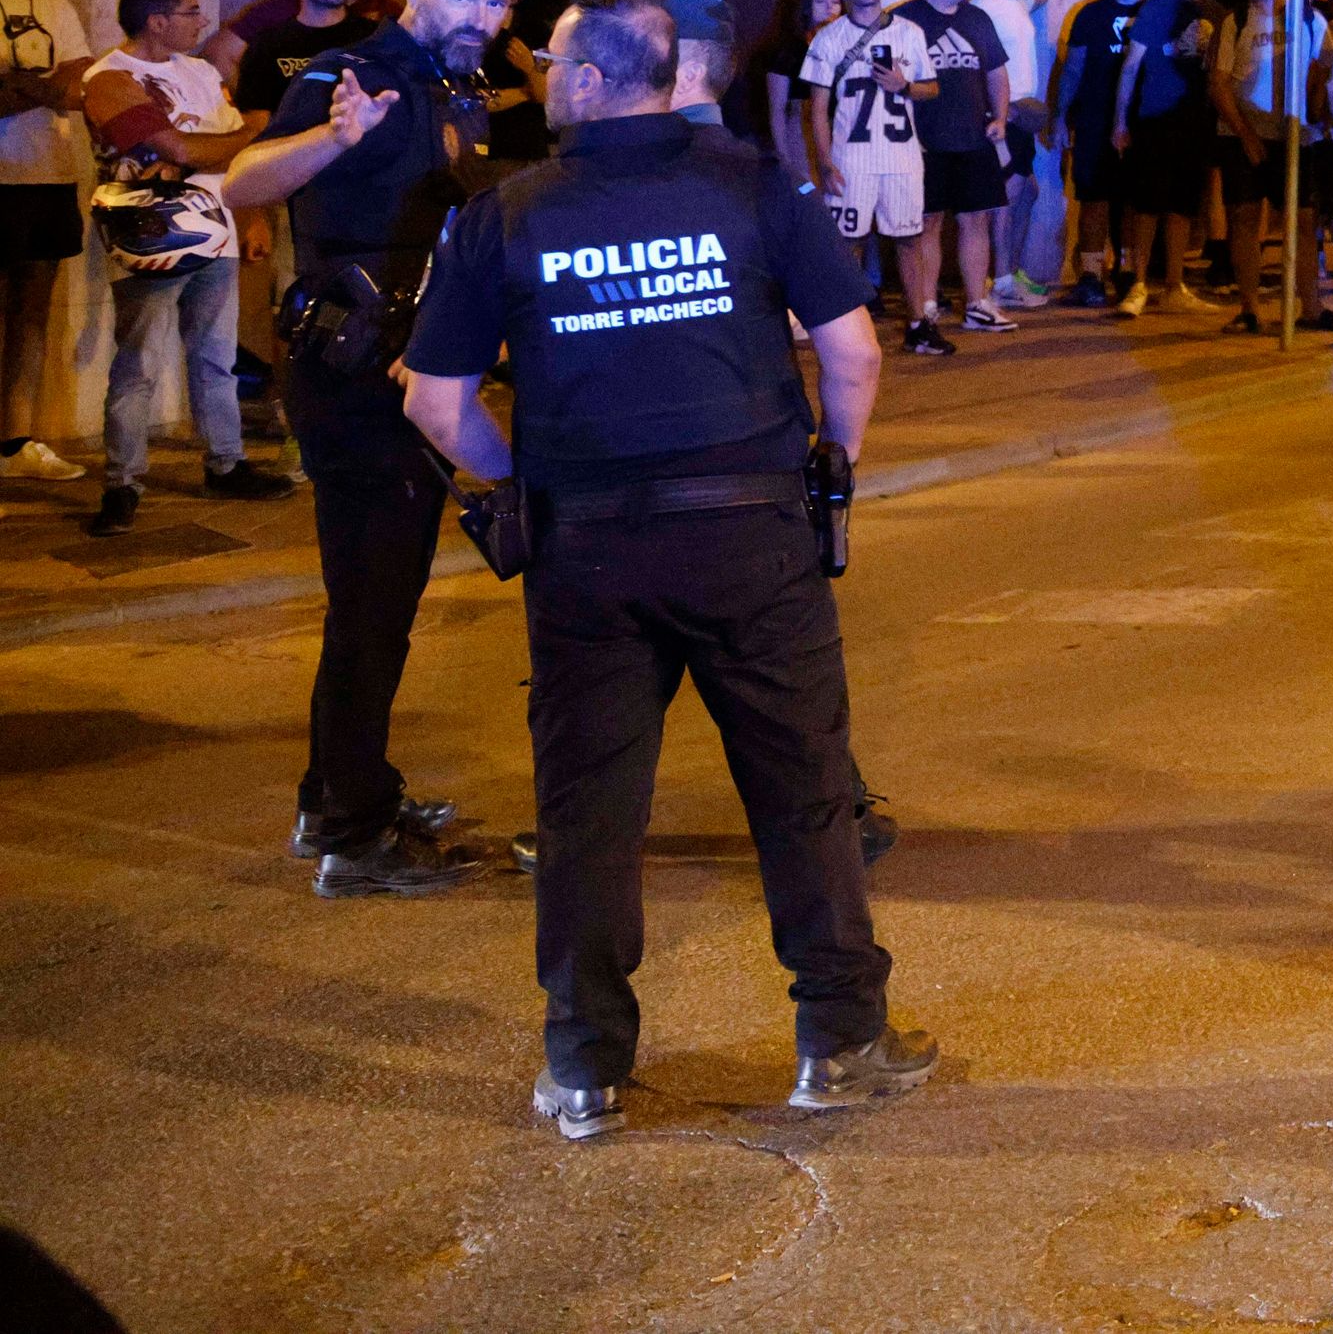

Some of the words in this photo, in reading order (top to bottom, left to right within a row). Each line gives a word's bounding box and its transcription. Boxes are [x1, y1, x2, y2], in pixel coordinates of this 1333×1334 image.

[830, 206, 859, 233] 79
[541, 233, 727, 283] POLICIA
[640, 267, 731, 299] LOCAL
[550, 310, 625, 334] TORRE
[629, 295, 734, 325] PACHECO
